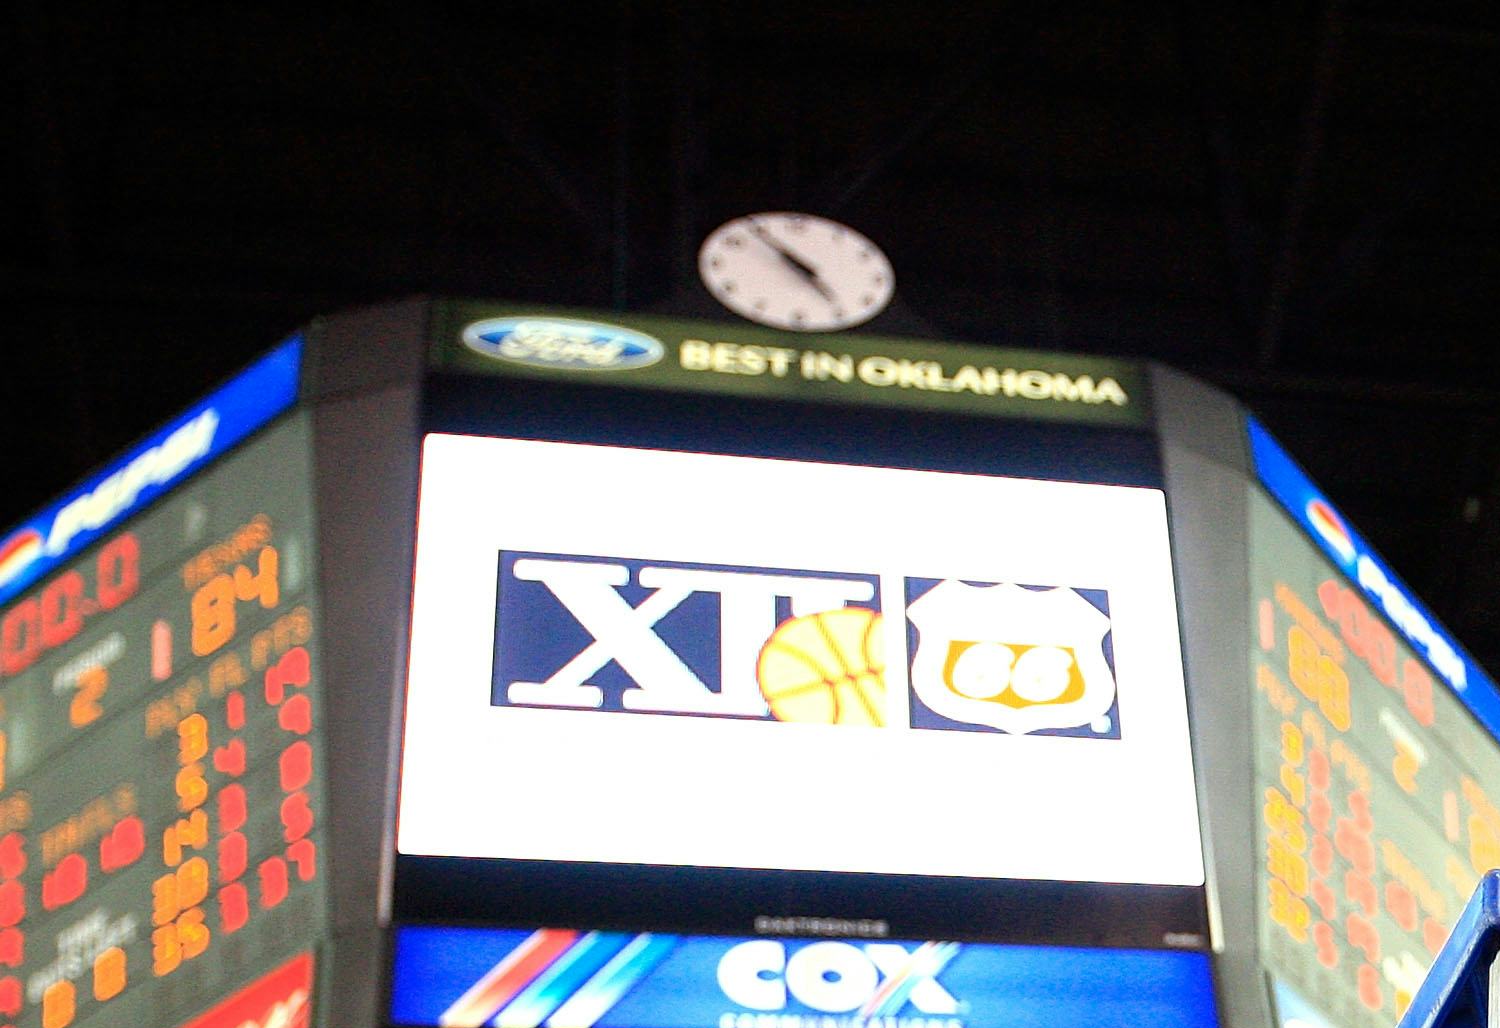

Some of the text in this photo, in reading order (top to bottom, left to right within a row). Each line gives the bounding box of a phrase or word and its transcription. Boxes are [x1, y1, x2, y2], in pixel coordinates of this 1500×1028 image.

[679, 339, 1128, 406] BEST IN OKLAHOMA
[191, 545, 279, 657] 84
[950, 640, 1074, 703] 66
[716, 939, 961, 1015] COX
